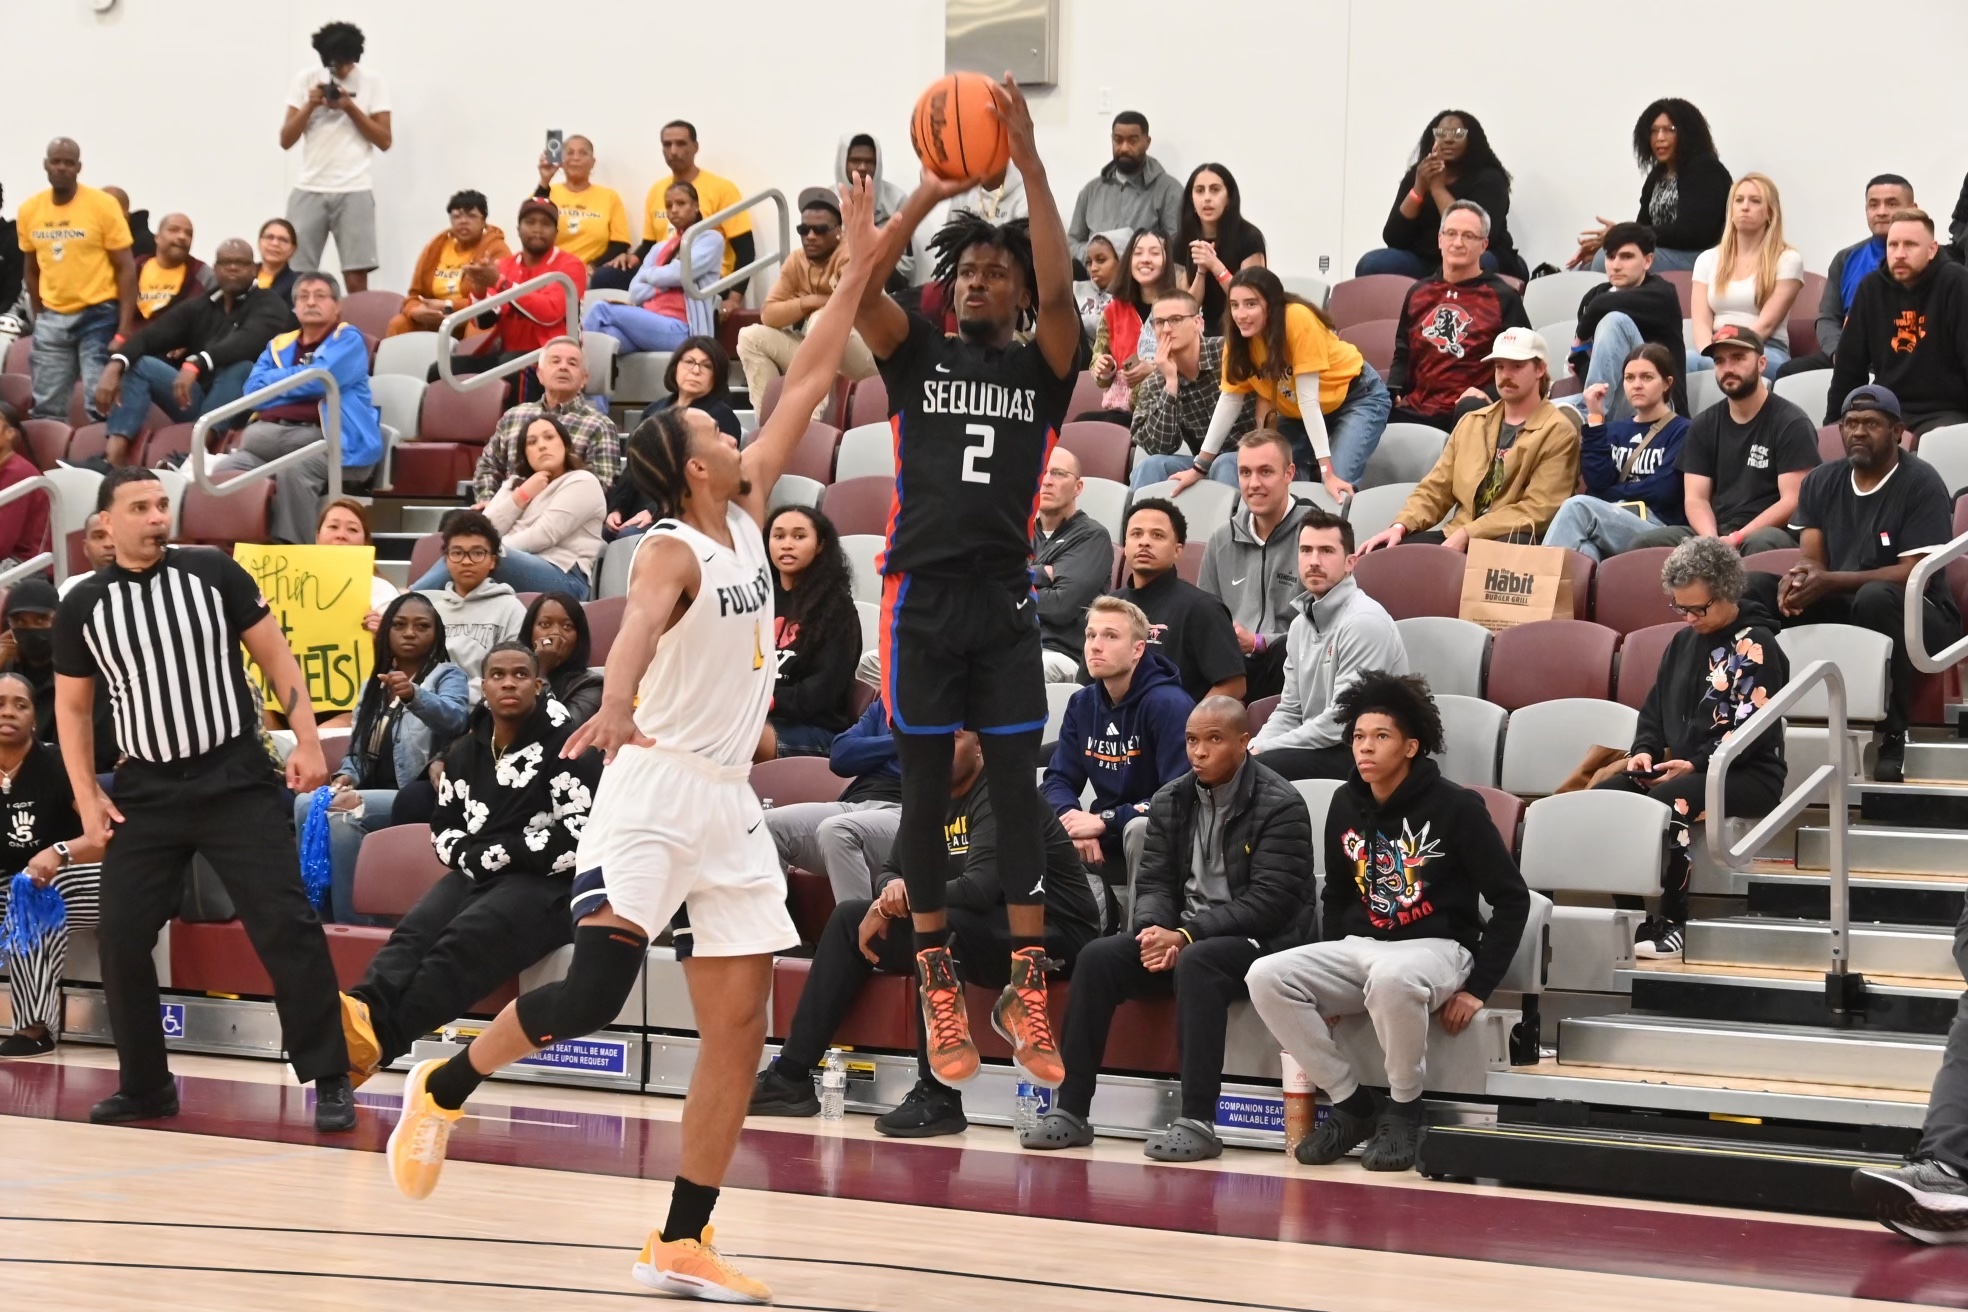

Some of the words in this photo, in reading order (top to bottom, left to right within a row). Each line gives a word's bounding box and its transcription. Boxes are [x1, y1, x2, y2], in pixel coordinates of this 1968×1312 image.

[922, 380, 1036, 423] SEQUOIAS
[961, 423, 995, 484] 2
[1484, 568, 1534, 594] Habit
[1485, 593, 1509, 602] BURGER
[1511, 595, 1528, 604] GRILL
[752, 618, 764, 672] 1
[12, 801, 35, 809] GOT
[16, 825, 33, 842] 5
[29, 839, 41, 847] IT
[556, 1044, 572, 1053] SEAT
[573, 1045, 588, 1054] WILL
[589, 1047, 599, 1056] BE
[600, 1048, 618, 1057] MADE
[560, 1055, 578, 1063] UPON
[580, 1057, 609, 1067] REQUEST
[1219, 1101, 1263, 1113] COMPANION
[1265, 1105, 1284, 1115] SEAT
[1317, 1110, 1329, 1119] MA
[1229, 1113, 1269, 1125] AVAILABLE
